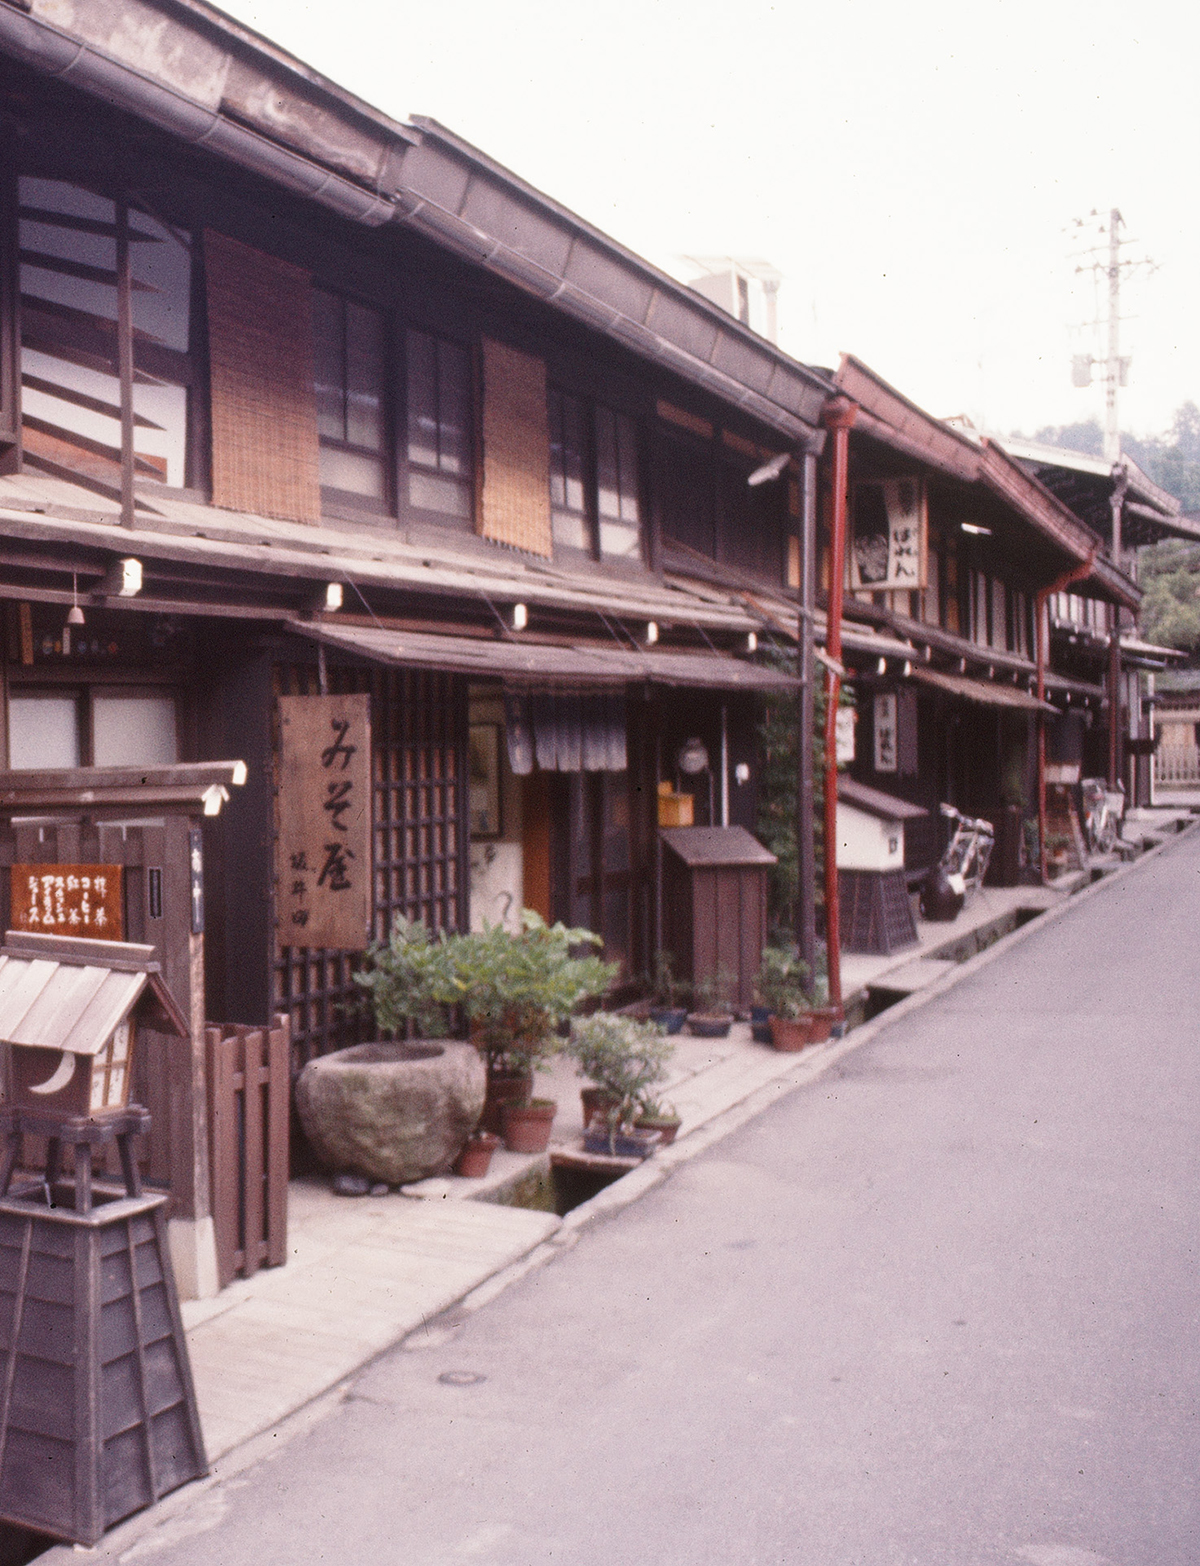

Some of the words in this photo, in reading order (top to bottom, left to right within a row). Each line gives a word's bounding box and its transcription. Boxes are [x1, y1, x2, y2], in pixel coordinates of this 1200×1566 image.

[317, 718, 357, 891] みそ屋
[81, 876, 91, 924] コーヒー
